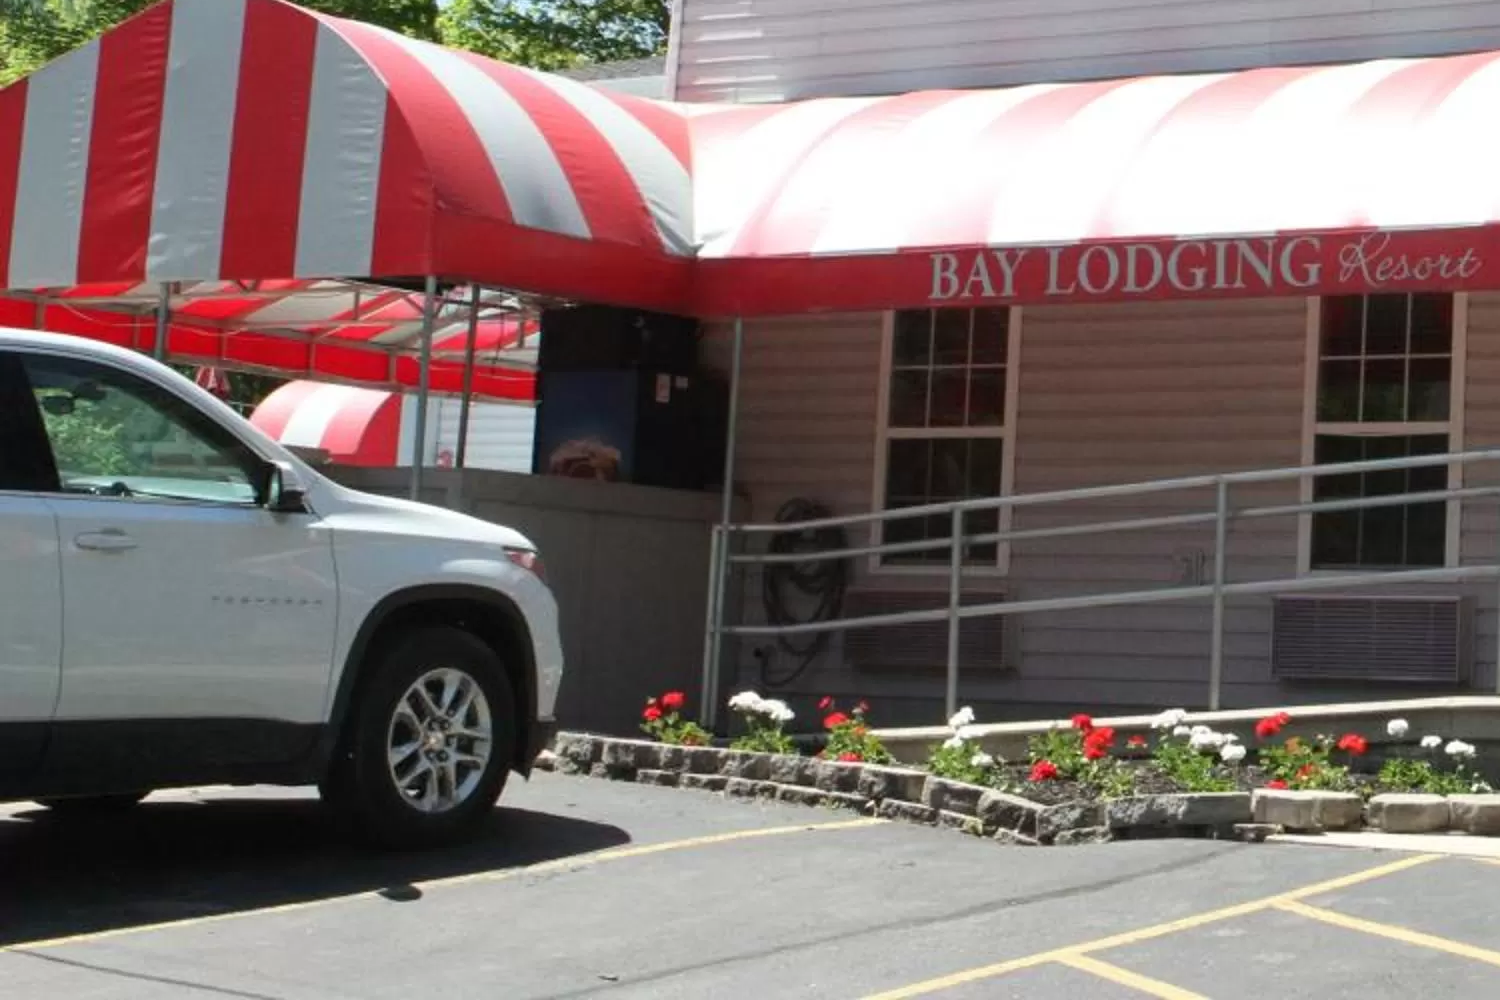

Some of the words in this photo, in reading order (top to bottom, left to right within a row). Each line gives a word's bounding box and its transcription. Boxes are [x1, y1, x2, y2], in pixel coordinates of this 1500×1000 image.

[927, 249, 1030, 300] BAY
[1044, 235, 1322, 296] LODGING
[1338, 230, 1482, 288] Resort
